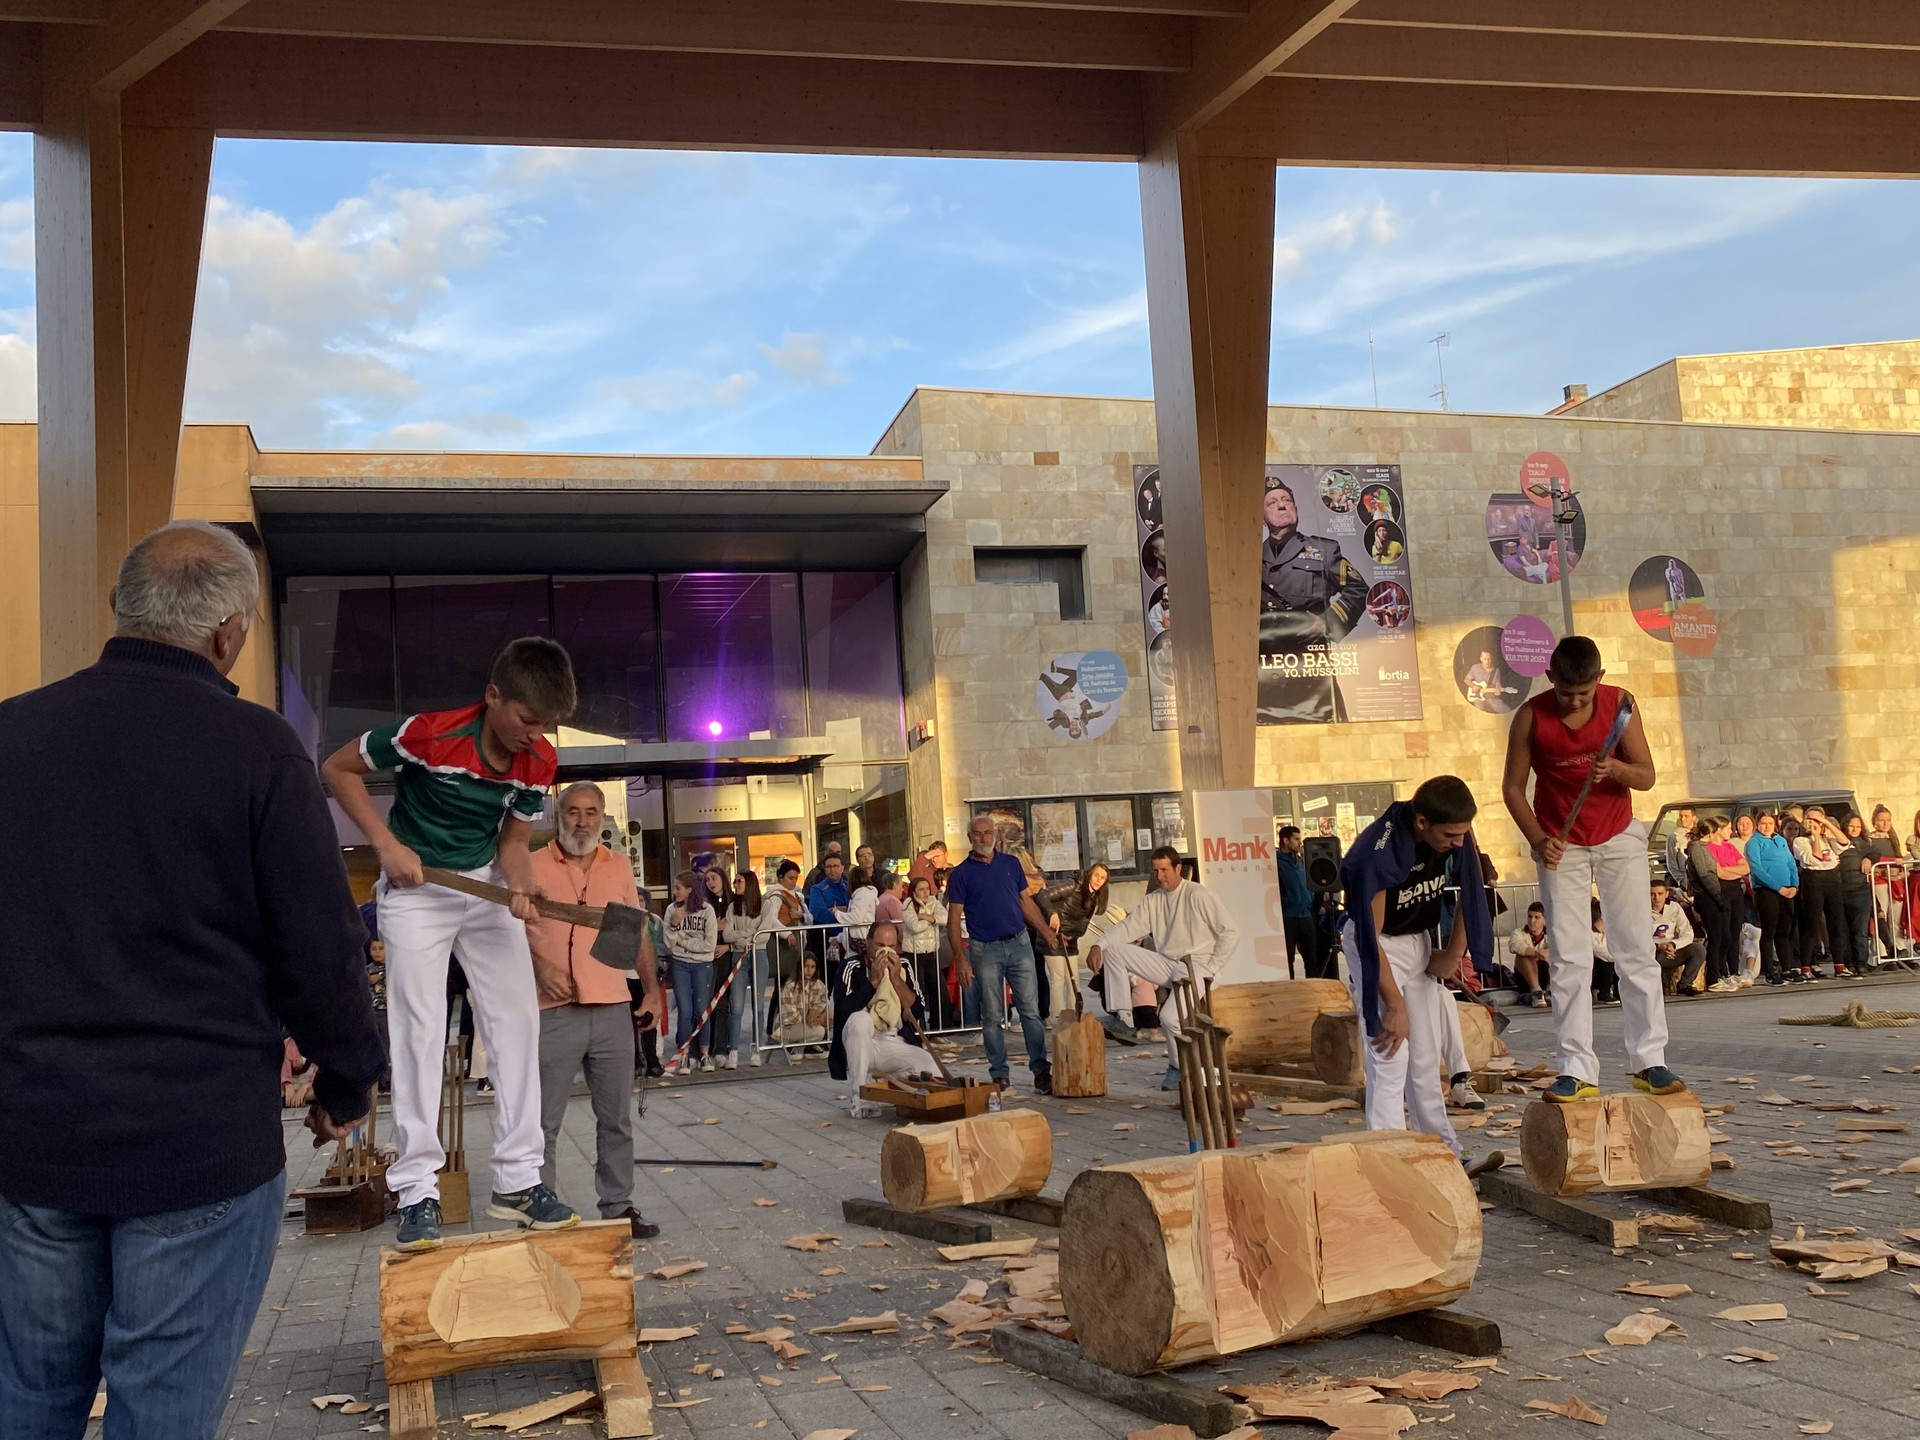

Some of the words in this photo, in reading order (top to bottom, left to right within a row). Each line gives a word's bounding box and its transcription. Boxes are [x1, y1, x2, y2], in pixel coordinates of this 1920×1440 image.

[1674, 622, 1717, 635] AMANTIS
[1260, 653, 1299, 669] LEO
[1302, 651, 1359, 668] BASSI
[1504, 654, 1530, 662] KULTUR
[1283, 668, 1301, 678] YO,
[1302, 666, 1360, 678] MUSSOLINI
[1203, 836, 1270, 862] Mank
[1205, 865, 1272, 874] sakana
